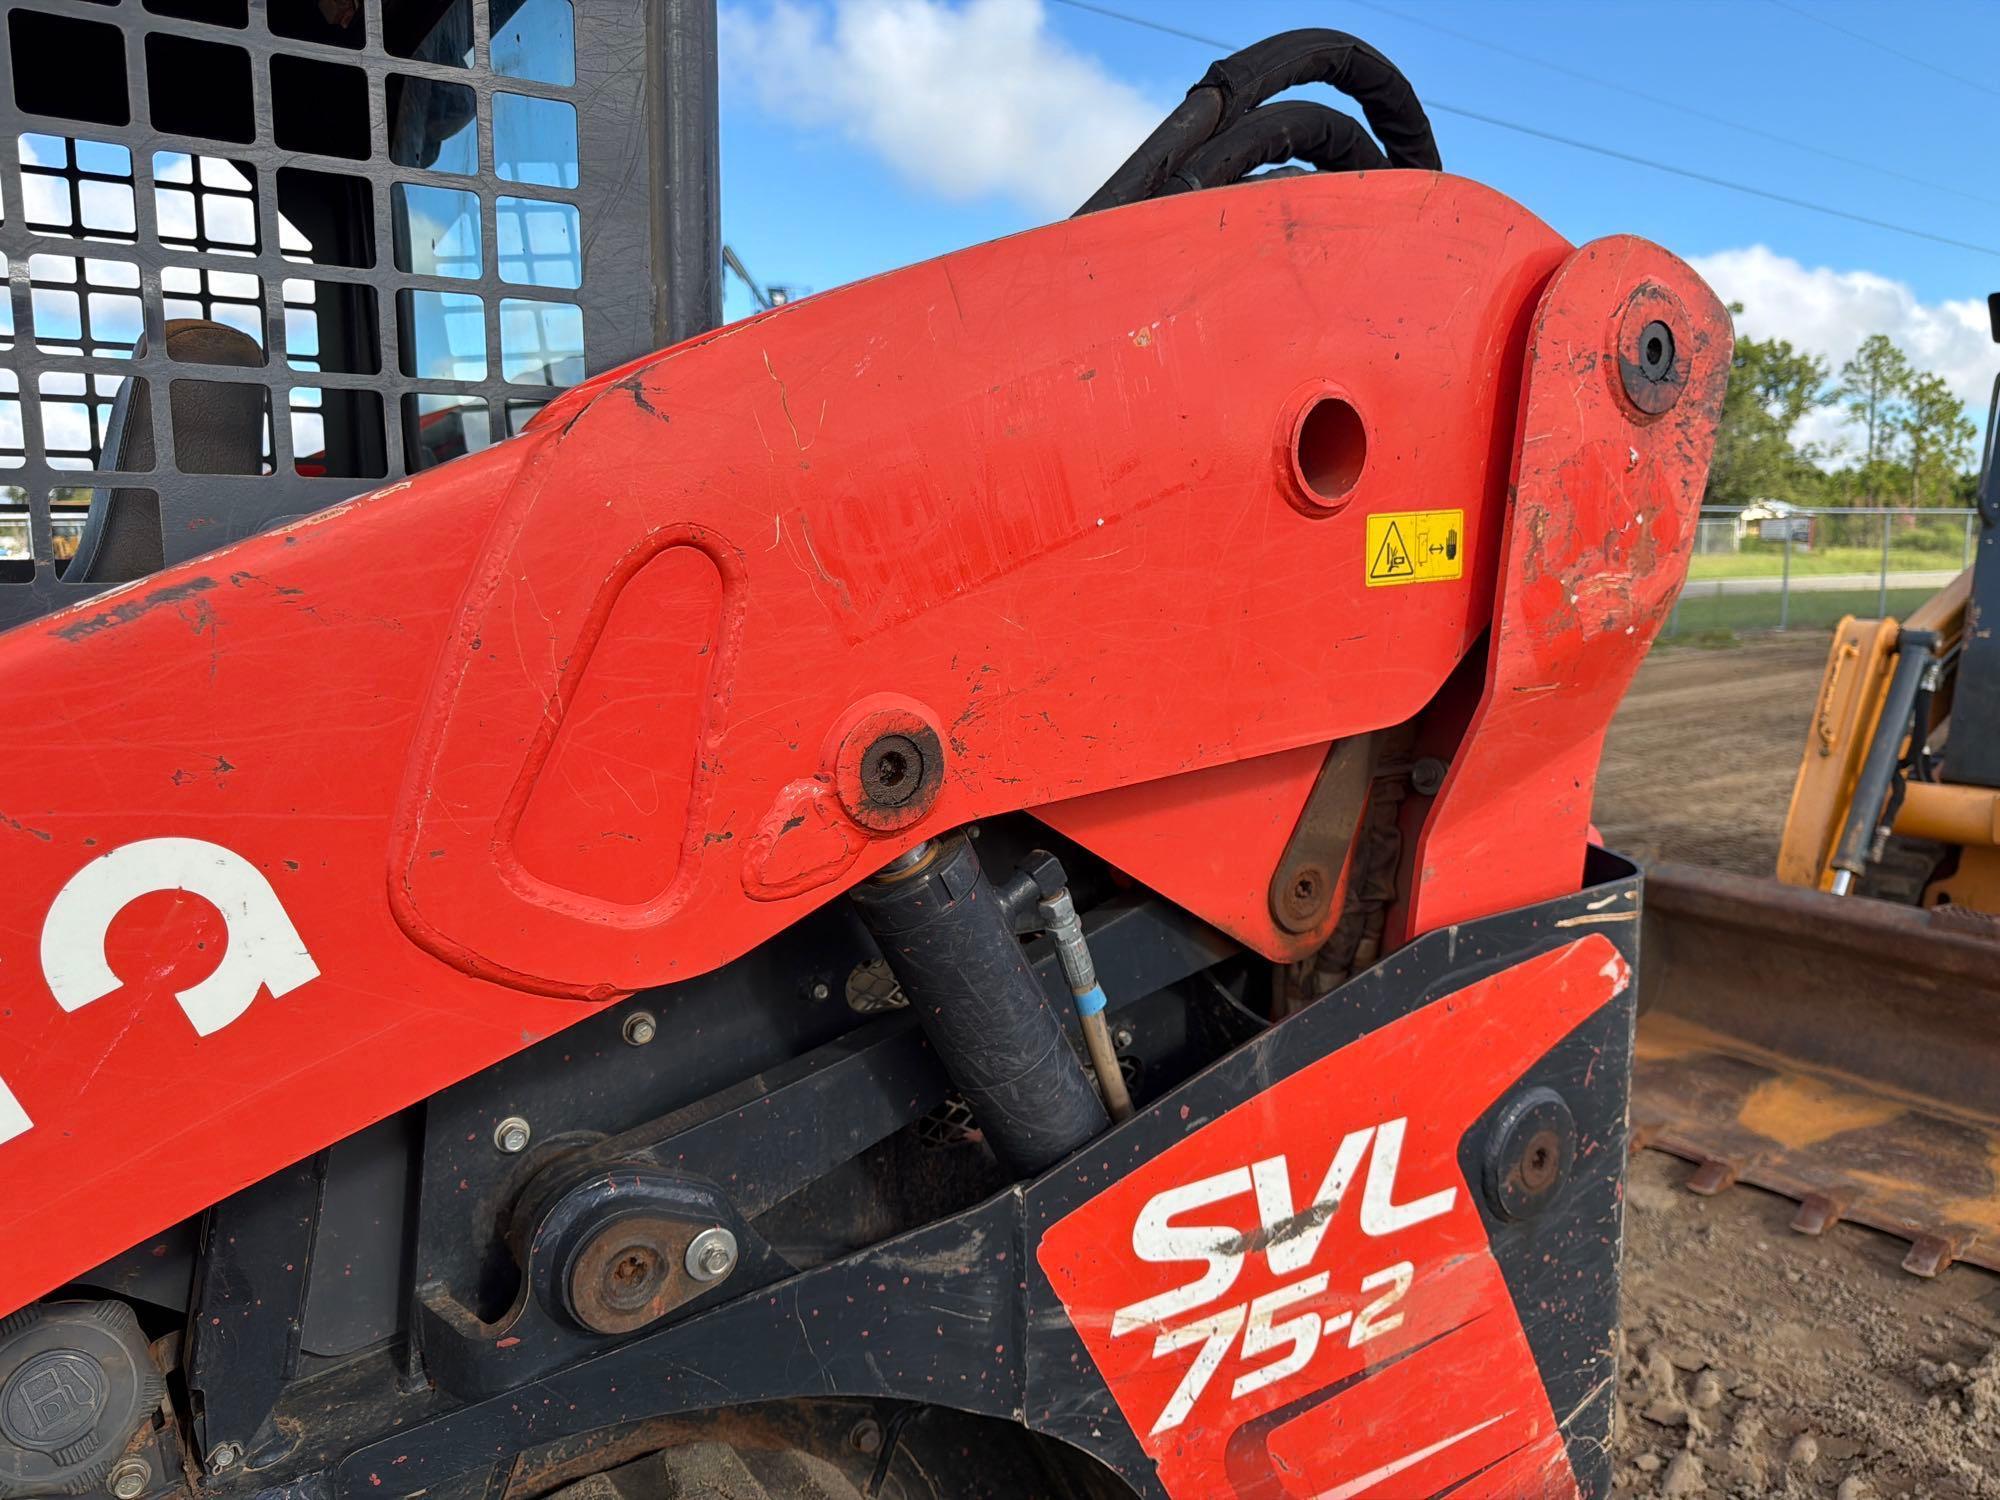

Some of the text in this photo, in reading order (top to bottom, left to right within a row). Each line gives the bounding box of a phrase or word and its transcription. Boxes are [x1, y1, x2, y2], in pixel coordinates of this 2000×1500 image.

[0, 837, 320, 1145] a
[1110, 1117, 1457, 1338] SVL
[1149, 1261, 1414, 1437] 75-2
